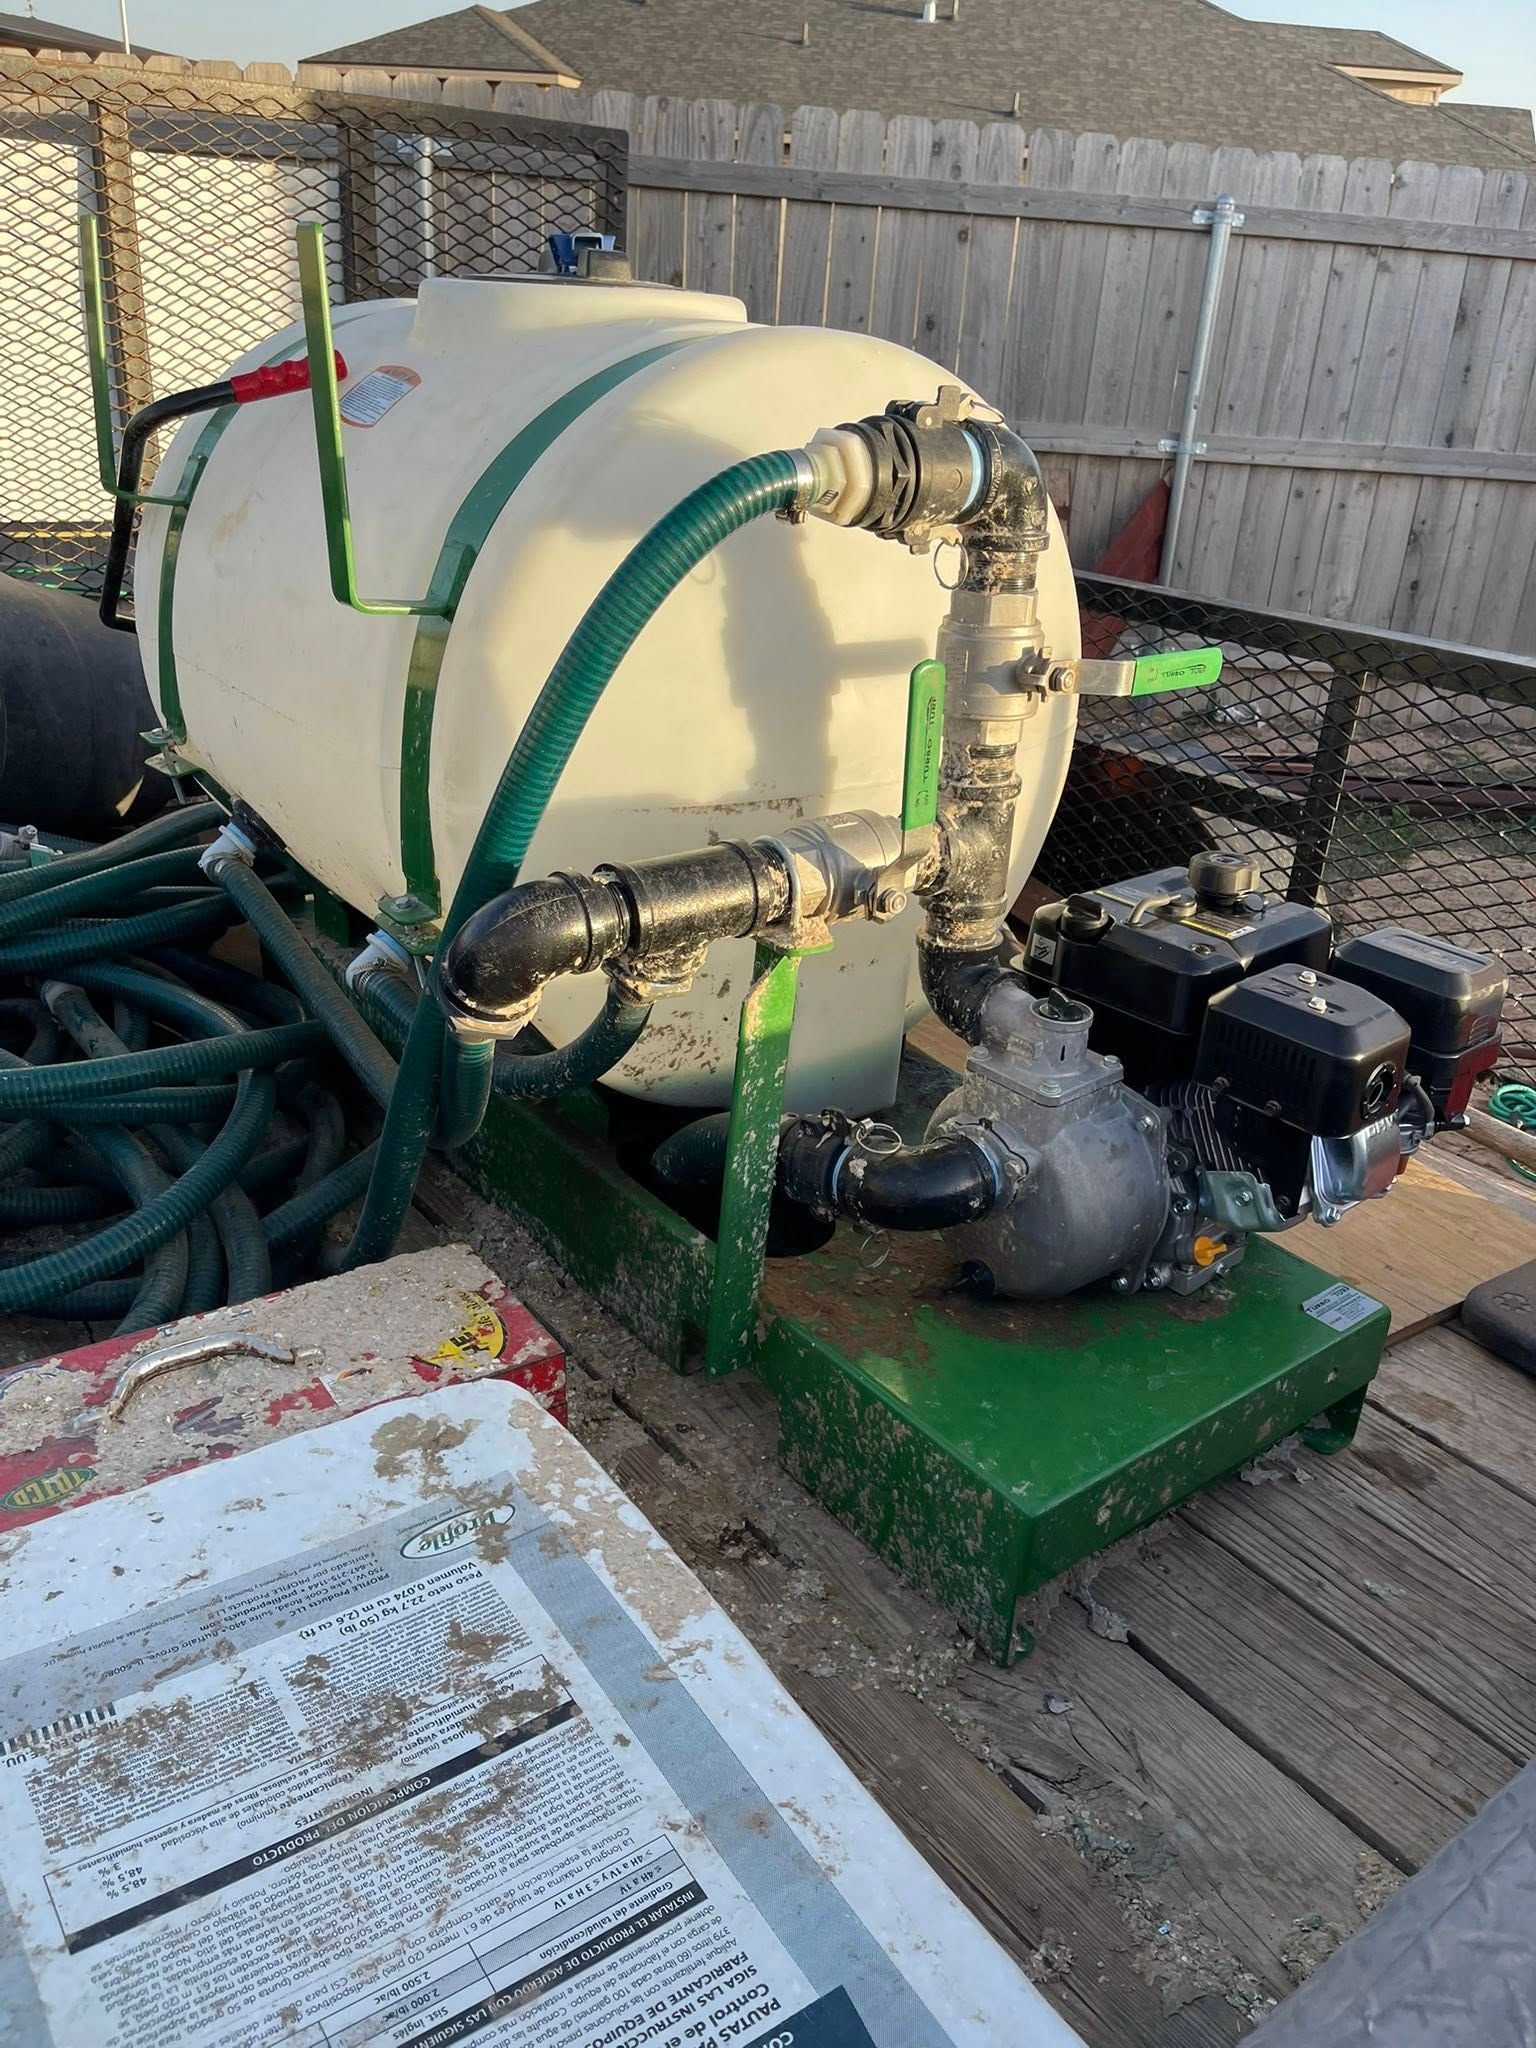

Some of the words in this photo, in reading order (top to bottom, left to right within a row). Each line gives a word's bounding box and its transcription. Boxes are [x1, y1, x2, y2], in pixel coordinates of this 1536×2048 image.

[1160, 670, 1186, 679] TURBO
[923, 738, 933, 784] TURBO
[1305, 1298, 1331, 1314] TURBO
[411, 1507, 502, 1555] Profile
[329, 1551, 376, 1572] Fabricado
[366, 1565, 385, 1576] 750
[328, 1578, 353, 1591] Lake
[350, 1572, 390, 1592] PROFILE
[425, 1560, 477, 1587] Volumen
[454, 1570, 483, 1586] Peso
[270, 1576, 311, 1595] PROFILE
[303, 1587, 329, 1601] Cook
[392, 1580, 426, 1601] 0,074
[426, 1582, 455, 1599] neto
[198, 1588, 298, 1632] profileproducts.com
[226, 1591, 270, 1612] Products
[273, 1596, 303, 1612] Road,
[307, 1588, 350, 1609] Products
[398, 1593, 426, 1610] 22,7
[247, 1608, 274, 1623] Suite
[287, 1605, 307, 1617] LLC
[333, 1608, 360, 1625] (2,6
[357, 1612, 380, 1627] (50
[398, 1740, 441, 1765] (máximo)
[309, 1757, 335, 1772] fibras
[258, 1772, 297, 1794] celulosa,
[233, 1790, 259, 1806] fibras
[241, 1789, 287, 1815] coloidales
[603, 1787, 638, 1809] máxima
[615, 1794, 643, 1813] Utilice
[185, 1807, 221, 1827] madera
[234, 1804, 278, 1830] (mínimo)
[562, 1804, 605, 1831] cobertura
[574, 1806, 617, 1835] máquinas
[142, 1823, 179, 1845] agentes
[160, 1824, 208, 1851] viscosidad
[528, 1828, 576, 1859] aprobadas
[589, 1826, 631, 1852] Consulte
[76, 1840, 143, 1873] humidificantes
[250, 1828, 320, 1866] PRODUCTO
[496, 1836, 541, 1865] superficie
[582, 1841, 623, 1869] longitud
[115, 1862, 144, 1882] 48,5
[507, 1852, 530, 1869] para
[514, 1851, 581, 1892] especificación
[119, 1873, 148, 1893] 48,5
[452, 1867, 482, 1888] suelo,
[462, 1870, 498, 1894] rociado
[546, 1864, 585, 1890] máxima
[417, 1881, 454, 1906] aplique
[422, 1894, 449, 1913] agua
[472, 1894, 502, 1915] datos
[505, 1892, 532, 1912] talud
[627, 1879, 674, 1910] Gradiente
[386, 1901, 418, 1922] Profile
[647, 1890, 695, 1923] INSTALAR
[681, 1904, 717, 1929] obtener
[341, 1922, 373, 1945] 50/50
[367, 1919, 405, 1944] toberas
[425, 1907, 474, 1939] completa
[684, 1920, 711, 1940] carga
[424, 1930, 461, 1956] metros
[536, 1913, 612, 1961] talud/condición
[578, 1924, 636, 1962] PRODUCTO
[616, 1921, 684, 1966] procedimientos
[690, 1936, 714, 1955] litros
[702, 1934, 739, 1962] Aplique
[311, 1940, 343, 1961] desde
[255, 1955, 312, 1989] direcciones
[291, 1956, 332, 1983] abanico
[379, 1957, 407, 1978] pies)
[616, 1951, 662, 1983] fabricante
[652, 1957, 677, 1978] libras
[659, 1956, 706, 1989] fertilizante
[666, 1950, 749, 2005] FABRICANTE
[723, 1963, 758, 1990] SIGA
[256, 1975, 292, 1999] (punta
[400, 1970, 432, 1992] 2.500
[511, 1964, 565, 2000] ACUERDO
[573, 1967, 607, 1992] mezcla
[629, 1971, 654, 1991] cada
[302, 1983, 328, 2002] para
[303, 1979, 365, 2018] dispositivos
[372, 1984, 401, 2007] lb/ac
[409, 1987, 441, 2010] 2.000
[486, 1992, 513, 2014] CON
[695, 1984, 724, 2007] LAS
[707, 1980, 772, 2027] Control
[380, 2001, 410, 2024] lb/ac
[424, 2005, 449, 2024] Sist.
[463, 2007, 488, 2026] LAS
[517, 1990, 567, 2024] instalación
[571, 1993, 613, 2024] galones)
[582, 2001, 631, 2035] soluciones
[644, 1999, 667, 2018] DE
[390, 2016, 426, 2042] inglés
[525, 2005, 569, 2036] Consulte
[682, 2019, 709, 2043] de
[716, 1996, 782, 2043] PAUTAS
[217, 2019, 261, 2048] detalles
[533, 2023, 560, 2044] agua
